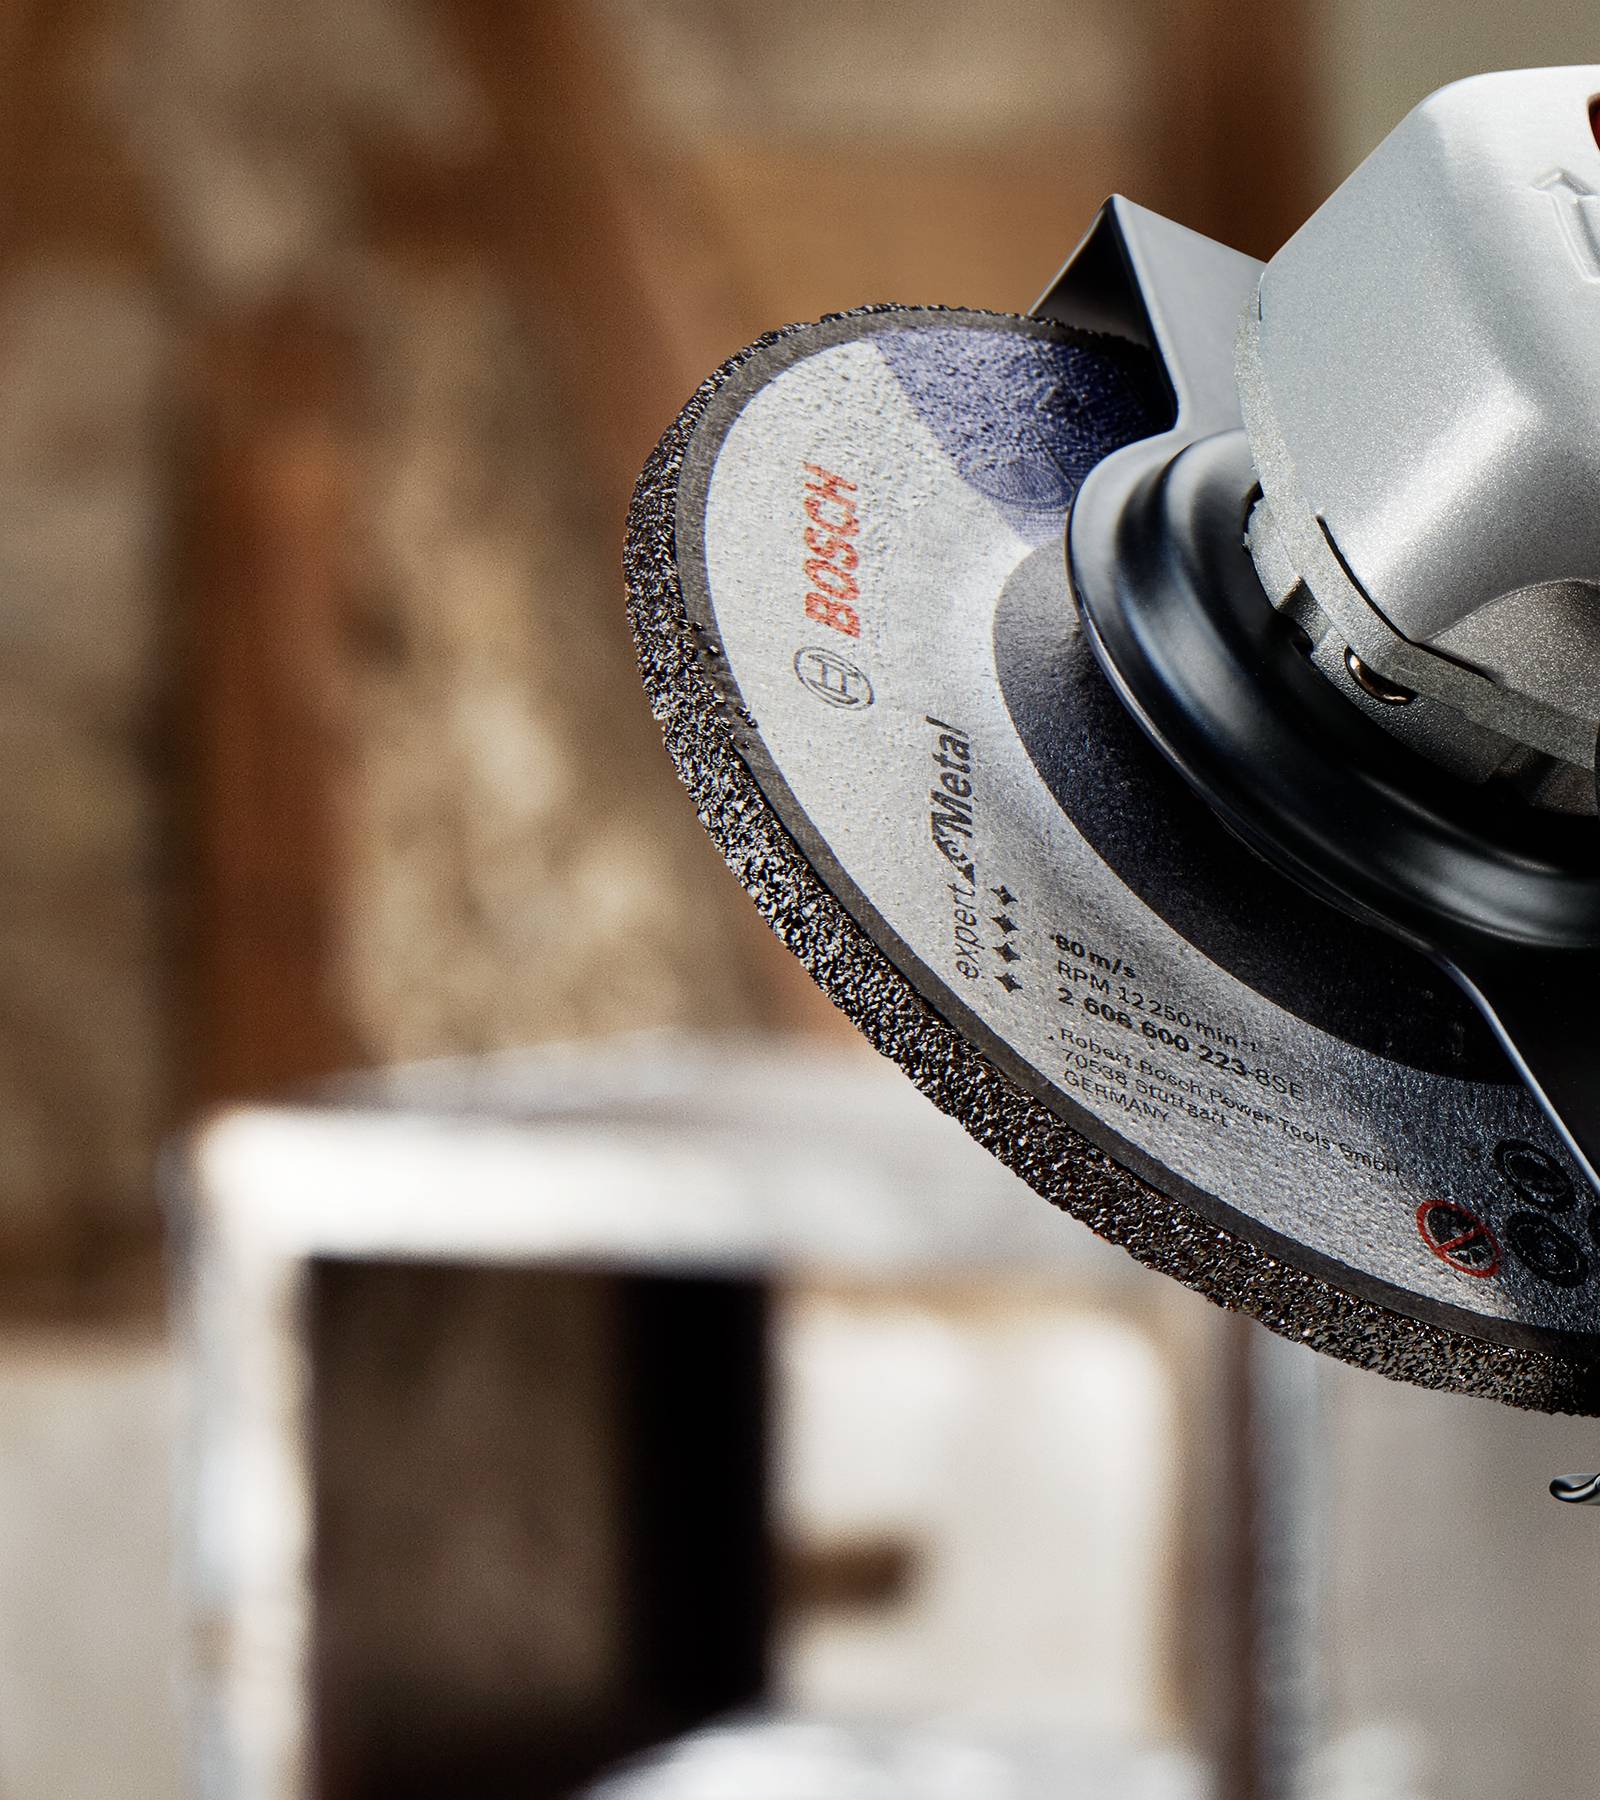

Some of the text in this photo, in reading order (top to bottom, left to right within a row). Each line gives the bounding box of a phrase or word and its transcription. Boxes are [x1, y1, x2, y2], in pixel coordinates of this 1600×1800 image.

[804, 462, 860, 639] BOSCH
[925, 714, 974, 839] Metal
[947, 882, 985, 981] expert
[1055, 933, 1137, 979] 80 m/s
[1057, 959, 1111, 995] RPM
[1057, 986, 1075, 1007] 2
[1140, 1020, 1191, 1053] 600
[1060, 1027, 1401, 1178] Robert Bosch Power Tools GmbH
[1061, 1048, 1229, 1128] 70538 Stuttgart
[1063, 1070, 1171, 1122] GERMANY
